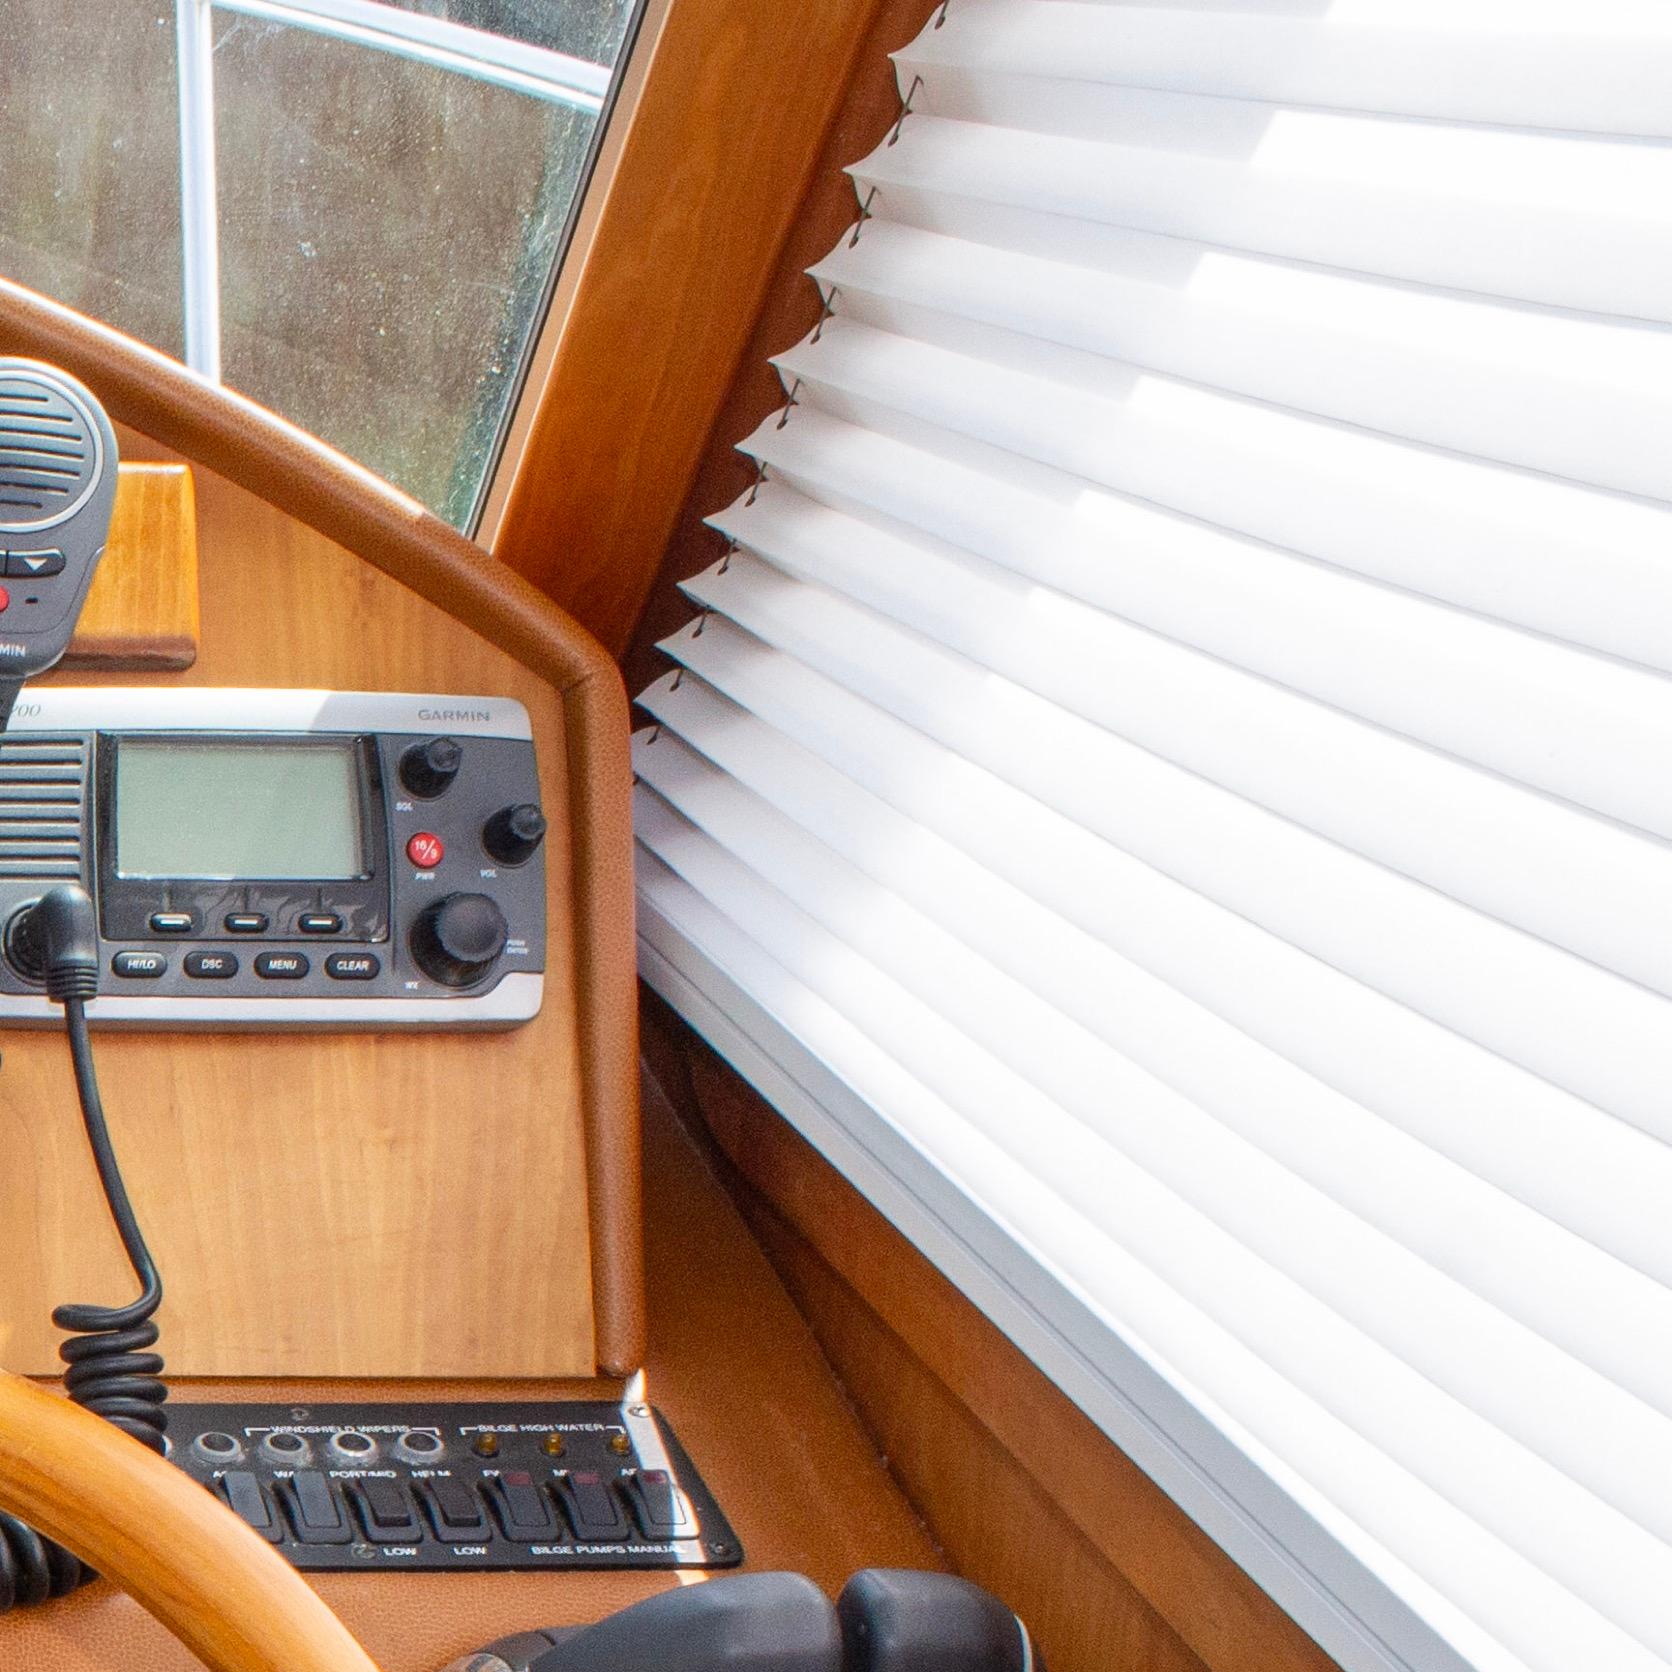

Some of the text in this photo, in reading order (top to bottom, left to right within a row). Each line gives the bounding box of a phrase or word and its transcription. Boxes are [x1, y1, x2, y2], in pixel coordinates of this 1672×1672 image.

[11, 704, 42, 717] 00
[417, 709, 491, 722] GARMIN
[480, 869, 498, 879] VOL
[127, 960, 157, 970] HI/LO
[200, 959, 224, 970] DSC
[268, 960, 298, 971] MENU
[336, 960, 370, 972] CLEAR
[357, 1426, 412, 1434] WIPERS
[477, 1423, 604, 1433] BILGE HIGH WATER
[383, 1547, 417, 1557] LOW
[454, 1547, 487, 1557] LOW
[530, 1546, 574, 1556] BILGE
[575, 1545, 626, 1555] PUMPS
